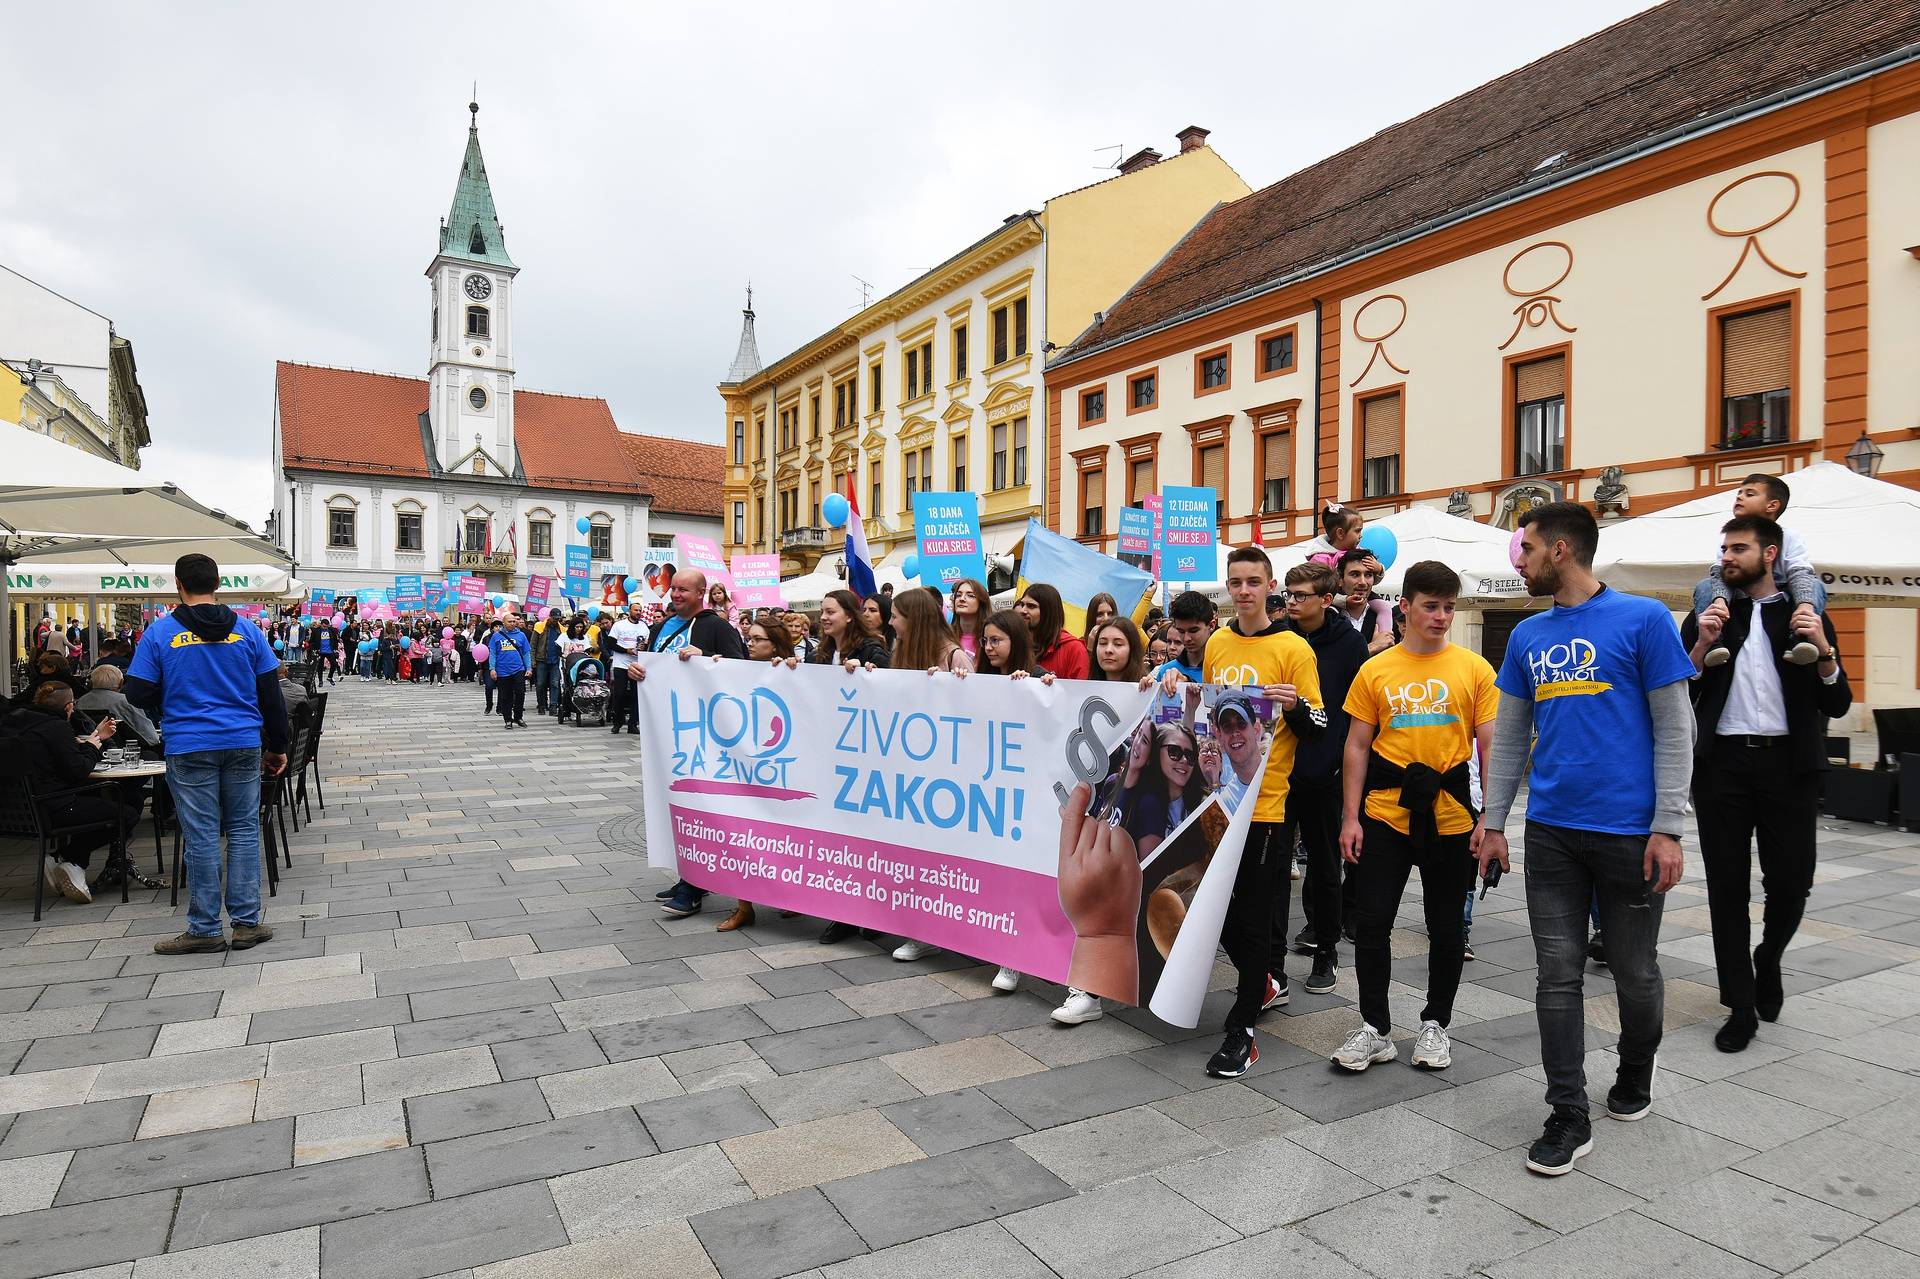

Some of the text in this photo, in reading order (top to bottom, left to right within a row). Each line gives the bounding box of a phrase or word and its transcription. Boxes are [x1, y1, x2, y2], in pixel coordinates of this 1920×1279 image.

[928, 506, 963, 519] 18 DANA
[1169, 500, 1208, 512] 12 TJEDANA
[1169, 515, 1208, 528] OD ZAČEĆA
[925, 522, 970, 536] OD ZAČEĆA
[1168, 532, 1188, 544] SMIJE
[1190, 533, 1199, 544] SE
[927, 540, 972, 553] KUCA SRCE
[645, 549, 675, 561] ZA ŽIVOT
[101, 575, 149, 589] PAN
[217, 575, 249, 588] AN
[1494, 579, 1522, 588] STEEL
[1840, 575, 1894, 586] COSTA
[1529, 638, 1597, 677] HOD
[1532, 666, 1600, 687] ZA ŽIVOT
[1384, 678, 1449, 708] HOD
[1390, 700, 1455, 717] ZA ŽIVOT
[670, 687, 792, 758] HOD
[835, 687, 1026, 781] ŽIVOT JE
[671, 744, 798, 790] ZA ŽIVOT
[833, 765, 1026, 842] ZAKON!
[675, 815, 981, 895] Tražimo zakonsku i svaku drugu zaštitu
[678, 843, 1018, 937] svakog čovjeka od začeća do prirodne smrti.
